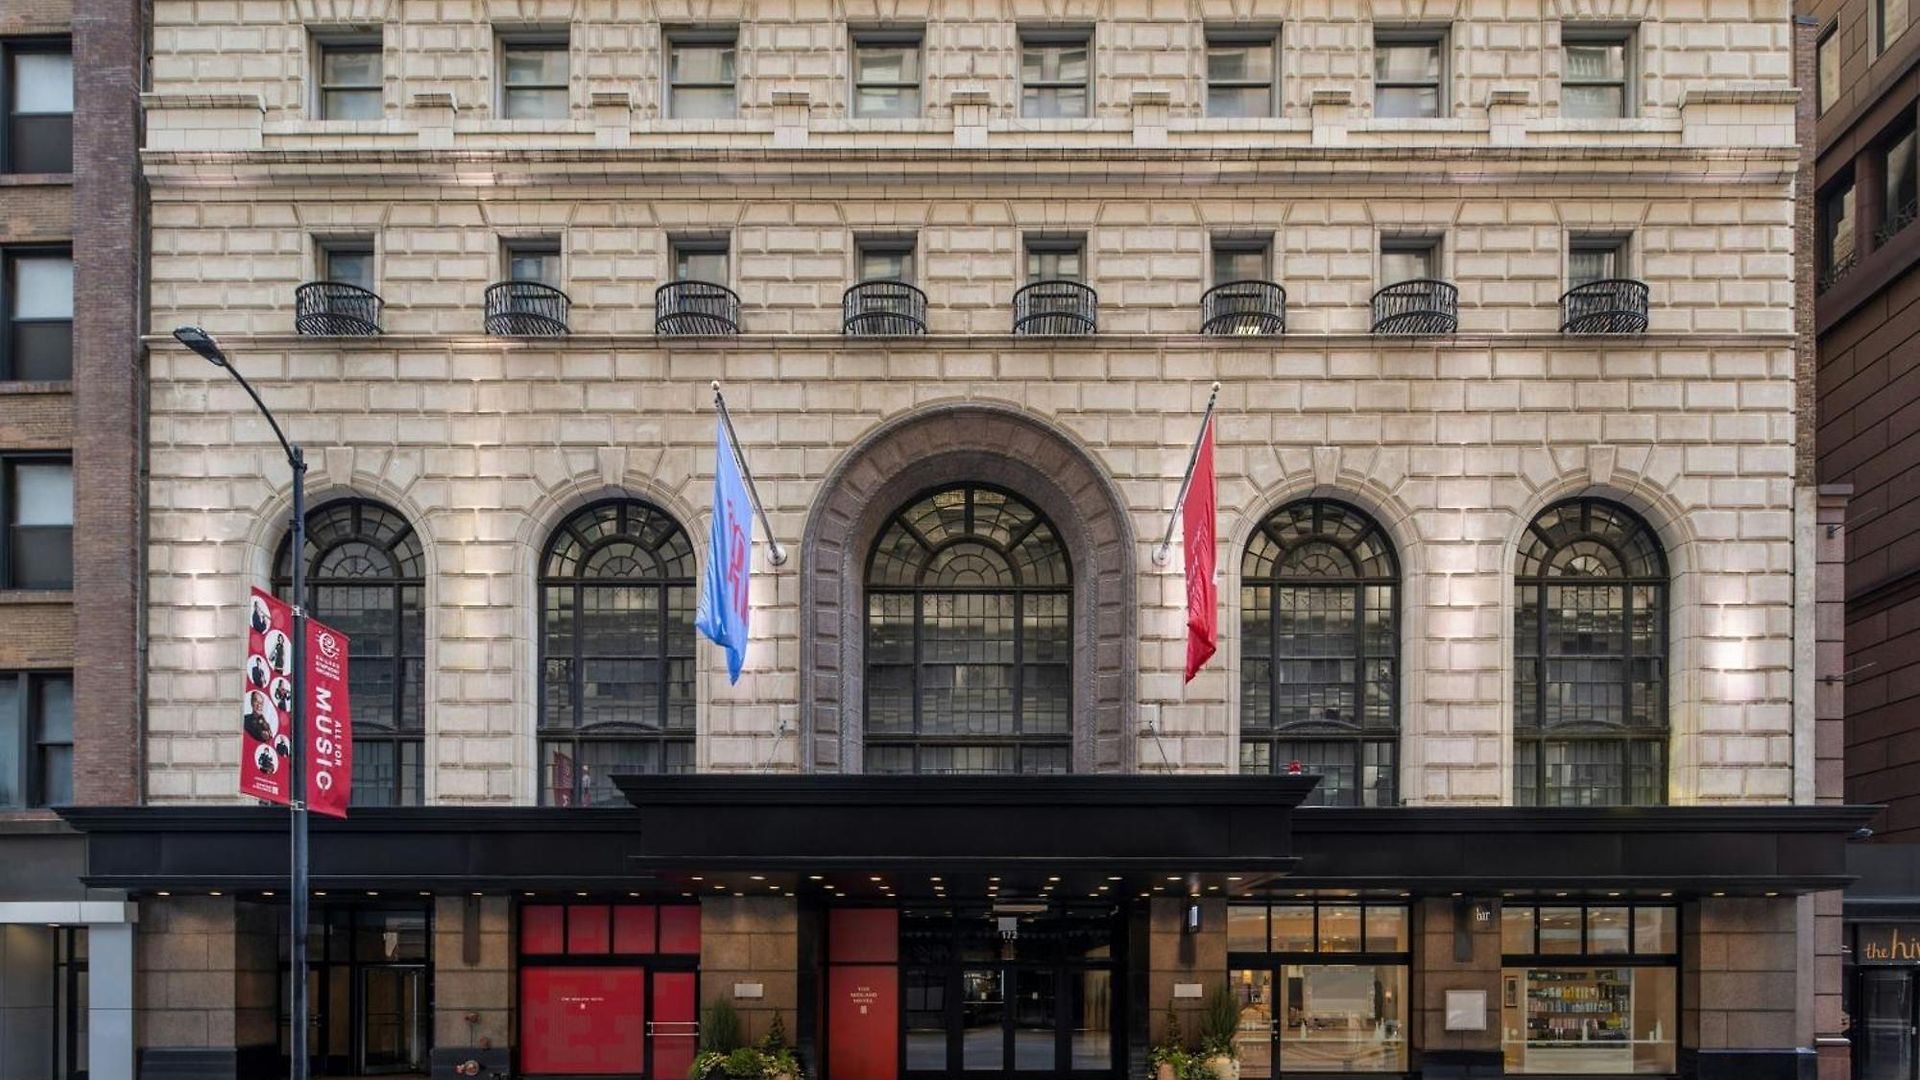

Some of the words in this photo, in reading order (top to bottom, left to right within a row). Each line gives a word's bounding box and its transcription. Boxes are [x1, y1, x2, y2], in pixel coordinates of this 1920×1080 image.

[316, 686, 333, 790] MUSIC
[334, 720, 342, 739] ALL
[334, 743, 342, 766] FOR
[1476, 907, 1490, 921] bar
[1002, 930, 1017, 939] 172
[1864, 942, 1888, 959] the
